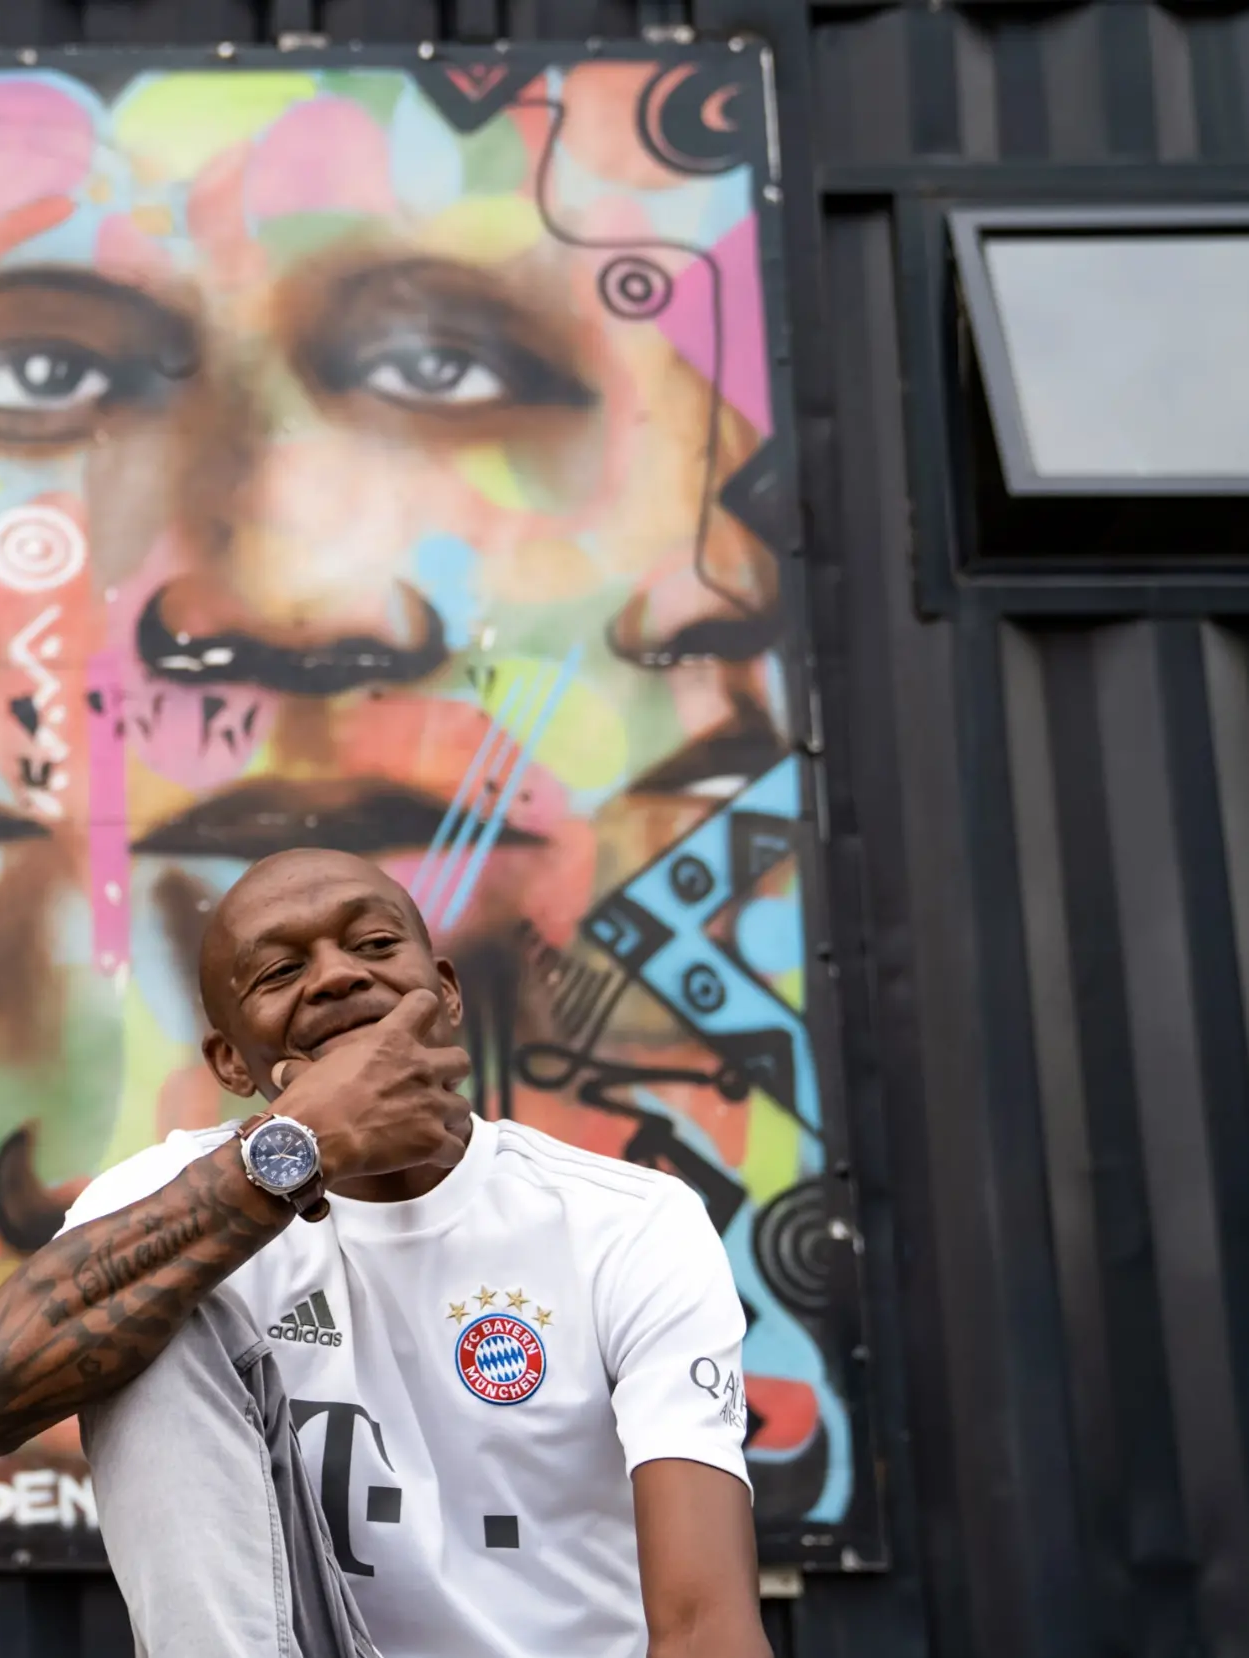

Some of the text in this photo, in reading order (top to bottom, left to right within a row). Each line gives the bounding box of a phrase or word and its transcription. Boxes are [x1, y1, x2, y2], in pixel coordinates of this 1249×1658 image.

[267, 1322, 343, 1347] adidas
[463, 1320, 539, 1355] FC BAYERN
[464, 1365, 539, 1398] MÜNCHEN
